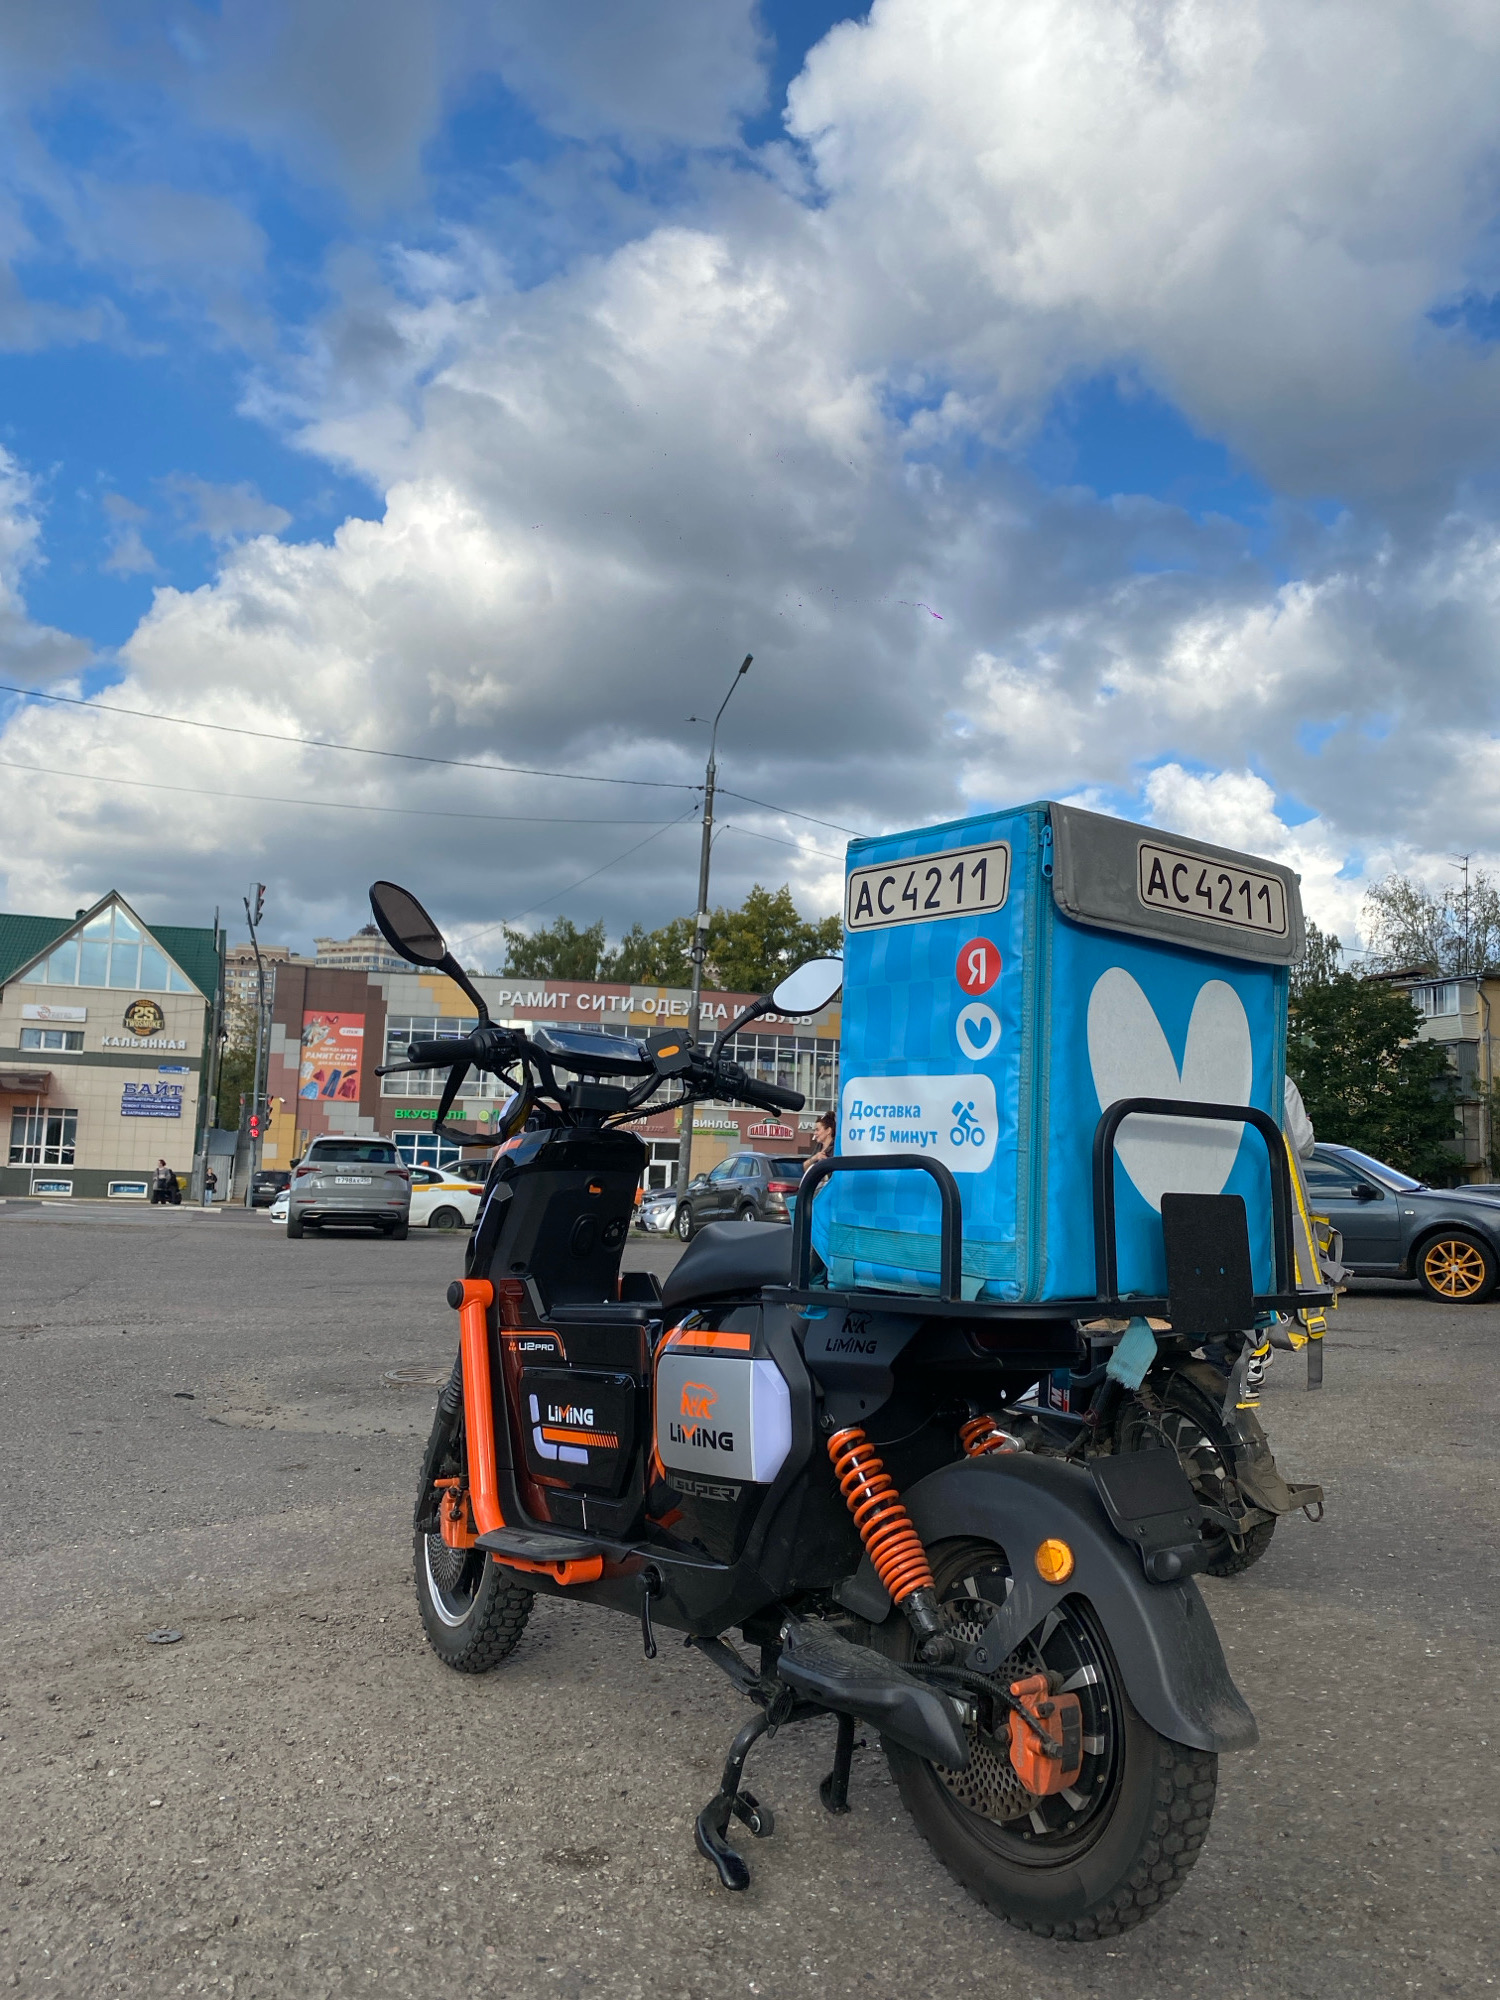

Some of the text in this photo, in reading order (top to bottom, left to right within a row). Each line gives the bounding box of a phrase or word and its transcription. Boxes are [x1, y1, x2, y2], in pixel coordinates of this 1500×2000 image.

[854, 857, 988, 920] АС4211
[1147, 857, 1272, 924] АС4211
[967, 948, 986, 985] Я
[499, 990, 570, 1008] РАМИТ
[576, 993, 634, 1013] СИТИ
[101, 1036, 187, 1049] КАЛЬЯННАЯ
[305, 1052, 357, 1061] РАМИТ СИТИ
[123, 1080, 184, 1096] БАЙТ
[394, 1109, 467, 1120] ВКУСВЛЛ
[849, 1100, 921, 1120] Доставка
[751, 1125, 768, 1137] ПАПА
[769, 1125, 793, 1138] ДЖОНС
[848, 1125, 938, 1148] от 15 минут
[518, 1341, 555, 1351] U2PRO
[674, 1479, 735, 1502] SUPER
